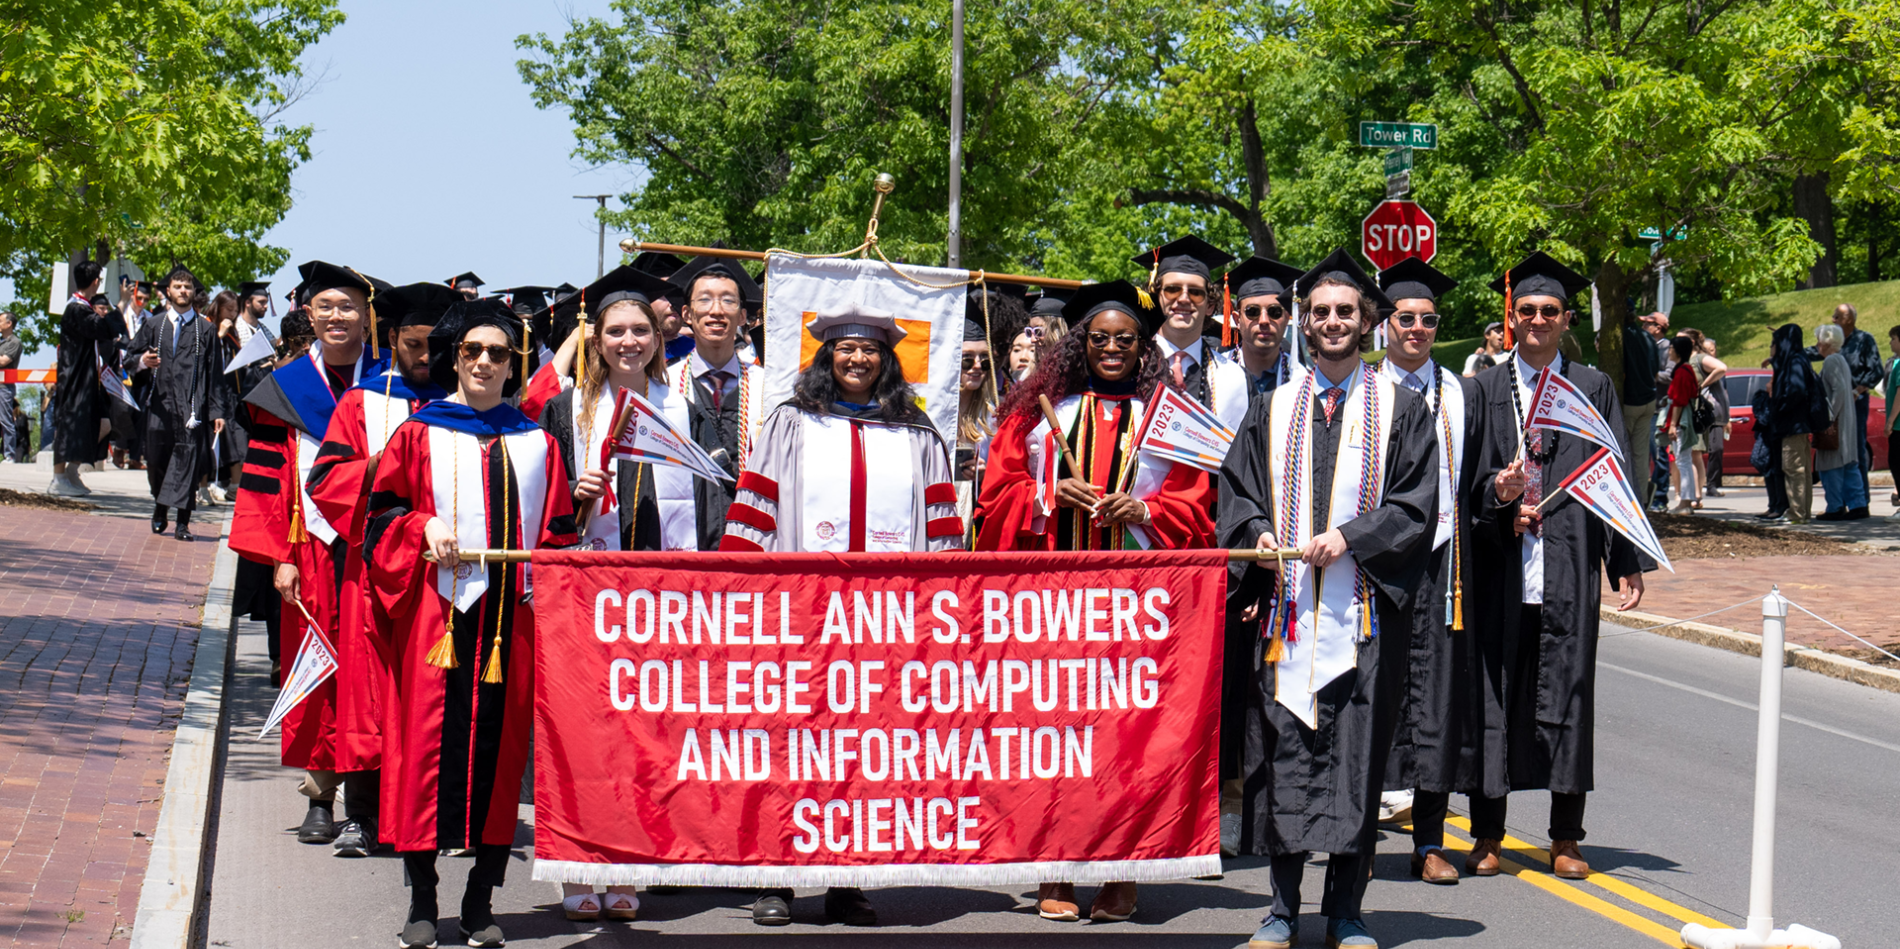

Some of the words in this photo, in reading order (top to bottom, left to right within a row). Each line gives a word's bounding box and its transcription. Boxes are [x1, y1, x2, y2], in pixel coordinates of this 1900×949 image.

[1366, 127, 1408, 142] Tower
[1412, 128, 1432, 143] Rd
[1367, 223, 1431, 252] STOP
[1538, 384, 1558, 415] 2023
[1152, 404, 1174, 437] 2023
[1580, 463, 1609, 490] 2023
[594, 589, 804, 645] CORNELL
[820, 591, 915, 644] ANN
[932, 590, 971, 644] S.
[983, 587, 1170, 643] BOWERS
[311, 639, 331, 667] 2023
[610, 659, 811, 713] COLLEGE
[827, 660, 884, 713] OF
[901, 657, 1158, 713] COMPUTING
[677, 728, 771, 781] AND
[788, 726, 1093, 781] INFORMATION
[793, 796, 980, 853] SCIENCE
